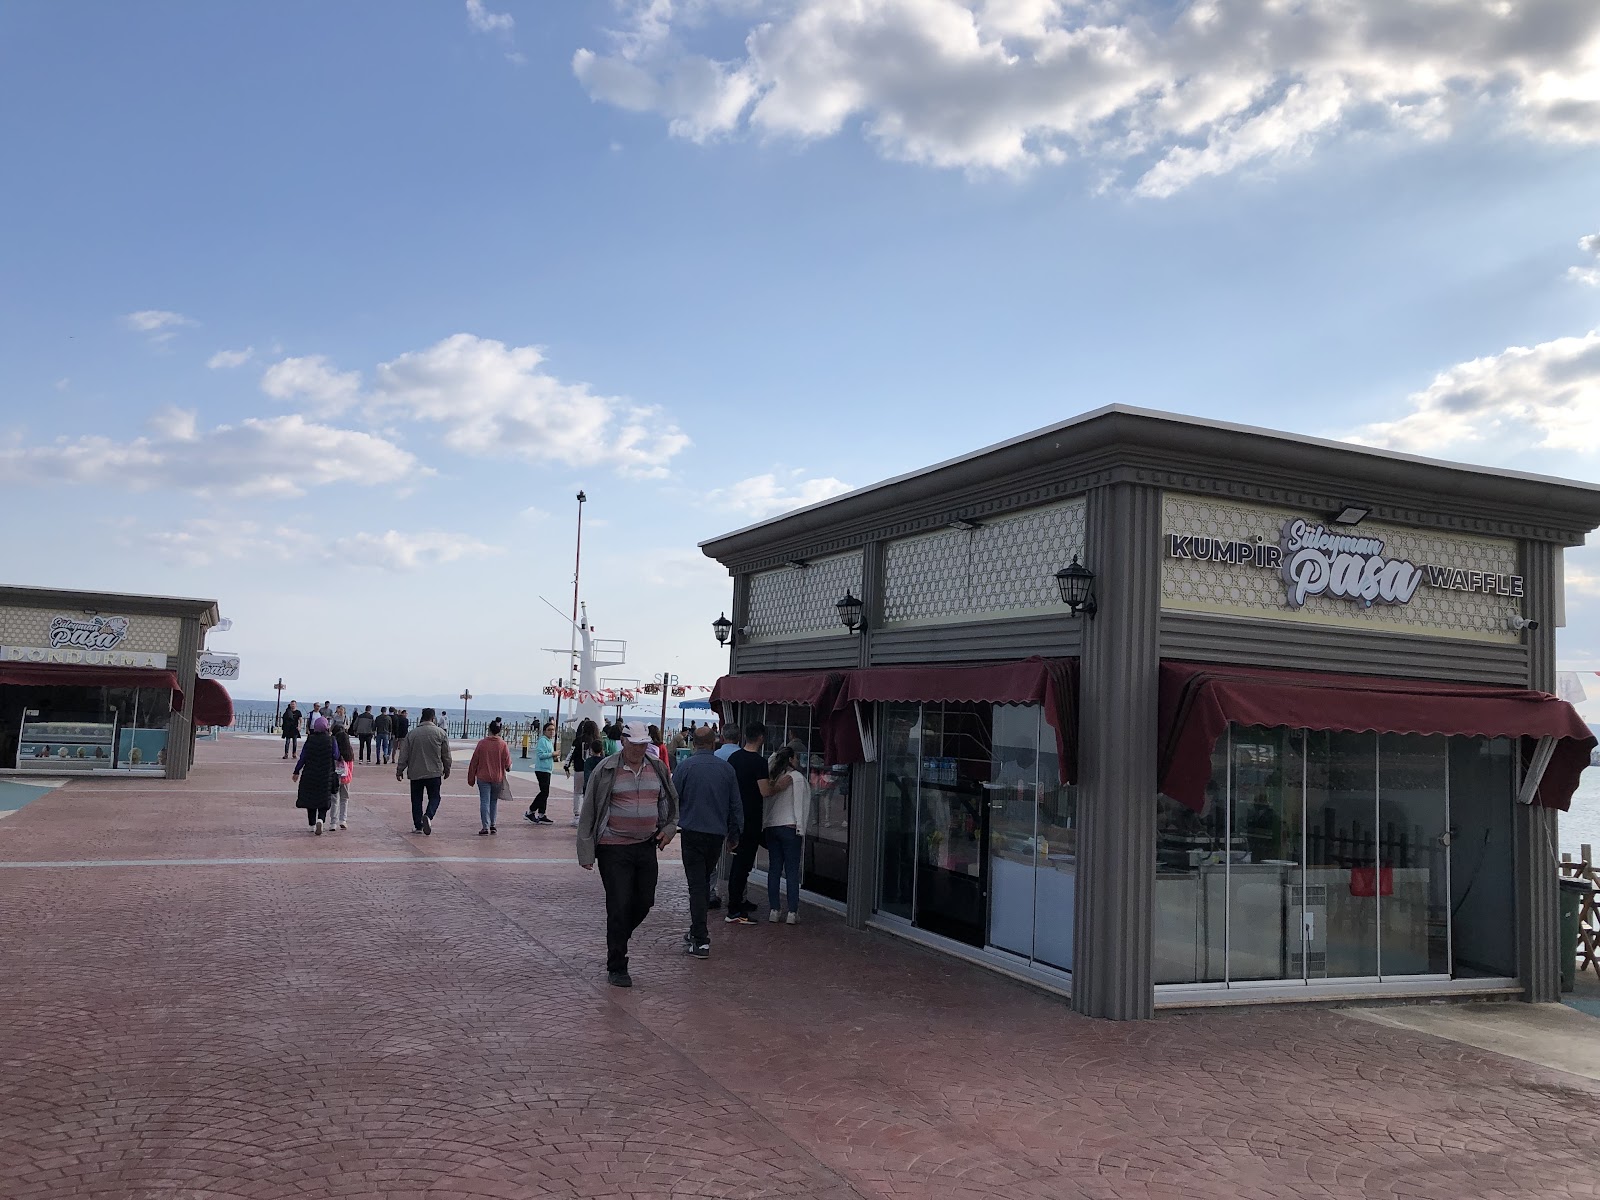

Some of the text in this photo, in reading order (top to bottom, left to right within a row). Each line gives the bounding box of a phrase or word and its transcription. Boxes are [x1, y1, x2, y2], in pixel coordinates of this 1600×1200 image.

[1168, 533, 1283, 569] KUMPİR
[1287, 519, 1385, 563] Süleyman
[1426, 563, 1525, 597] WAFFLE
[7, 648, 157, 668] DONDURMA
